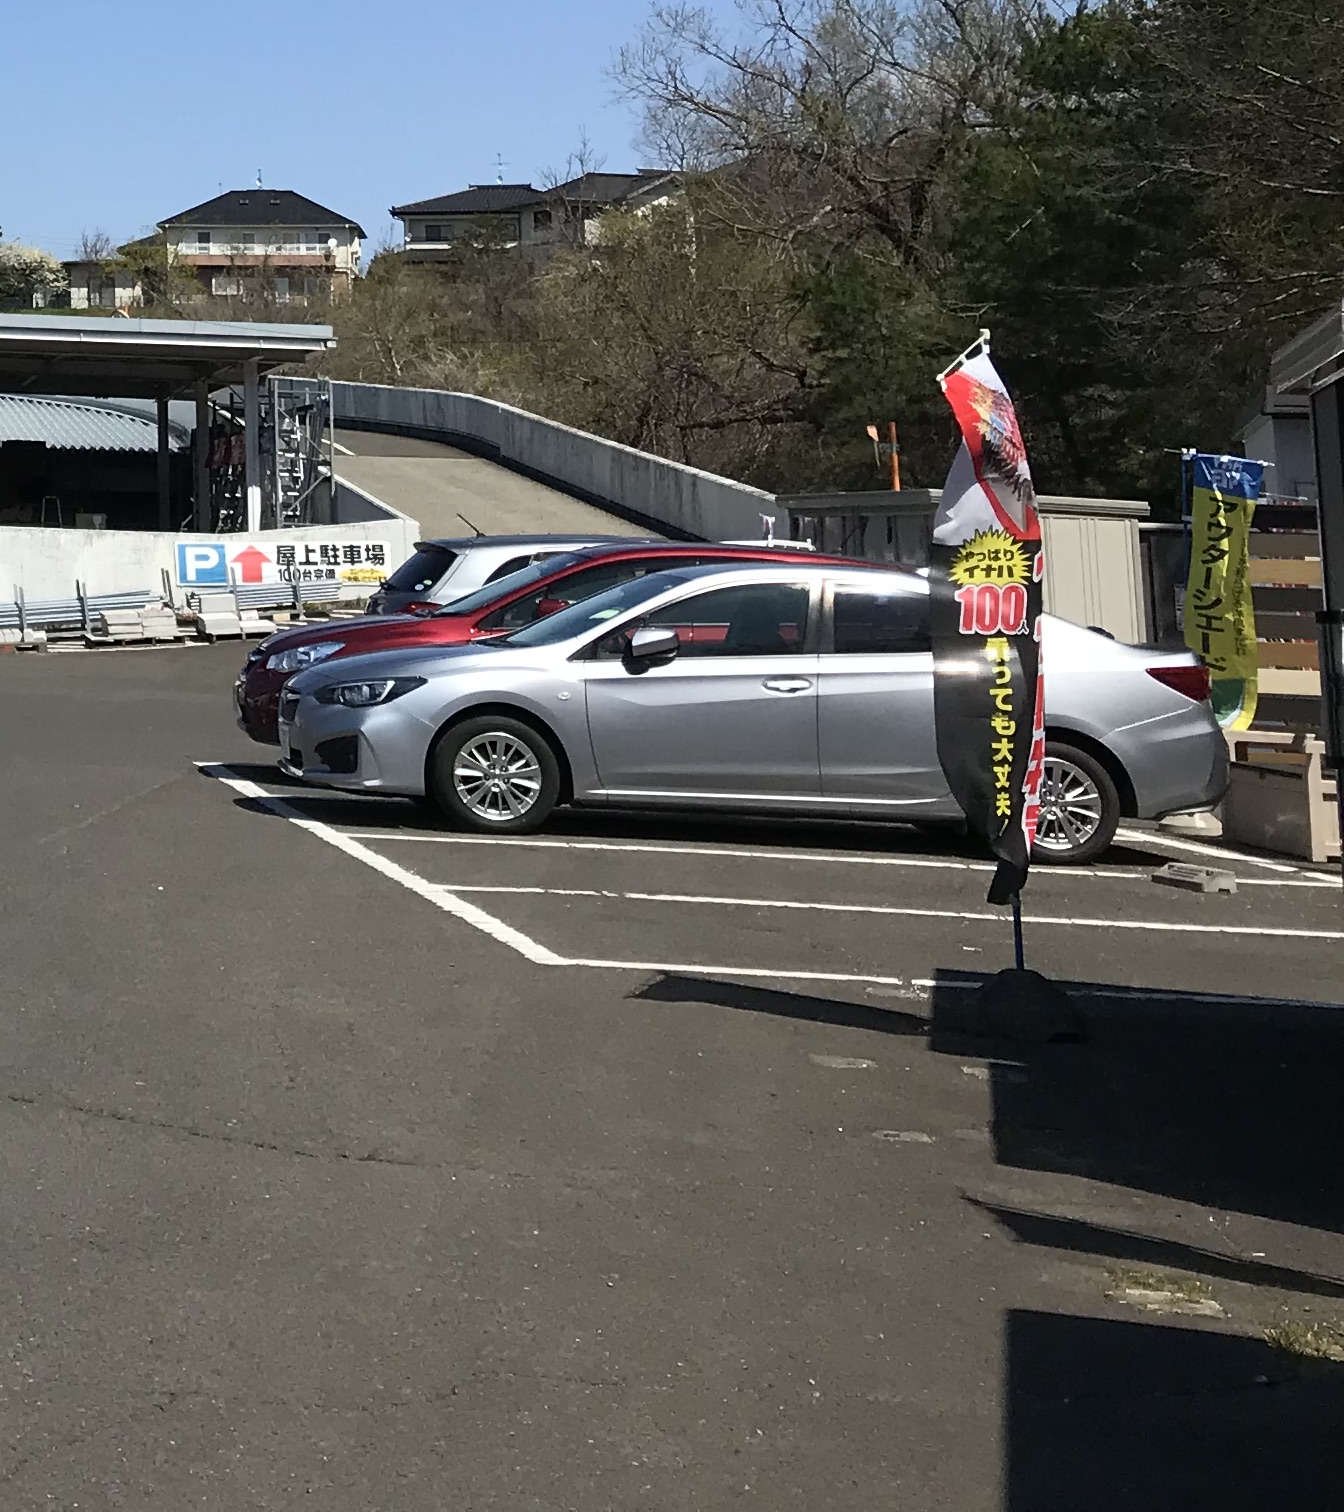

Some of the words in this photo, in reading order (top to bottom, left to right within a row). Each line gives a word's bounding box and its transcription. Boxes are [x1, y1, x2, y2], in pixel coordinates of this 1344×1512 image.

[185, 547, 219, 581] P
[275, 544, 385, 567] 屋上駐車場
[963, 548, 1015, 562] やっぱり
[963, 564, 1017, 579] イナバ
